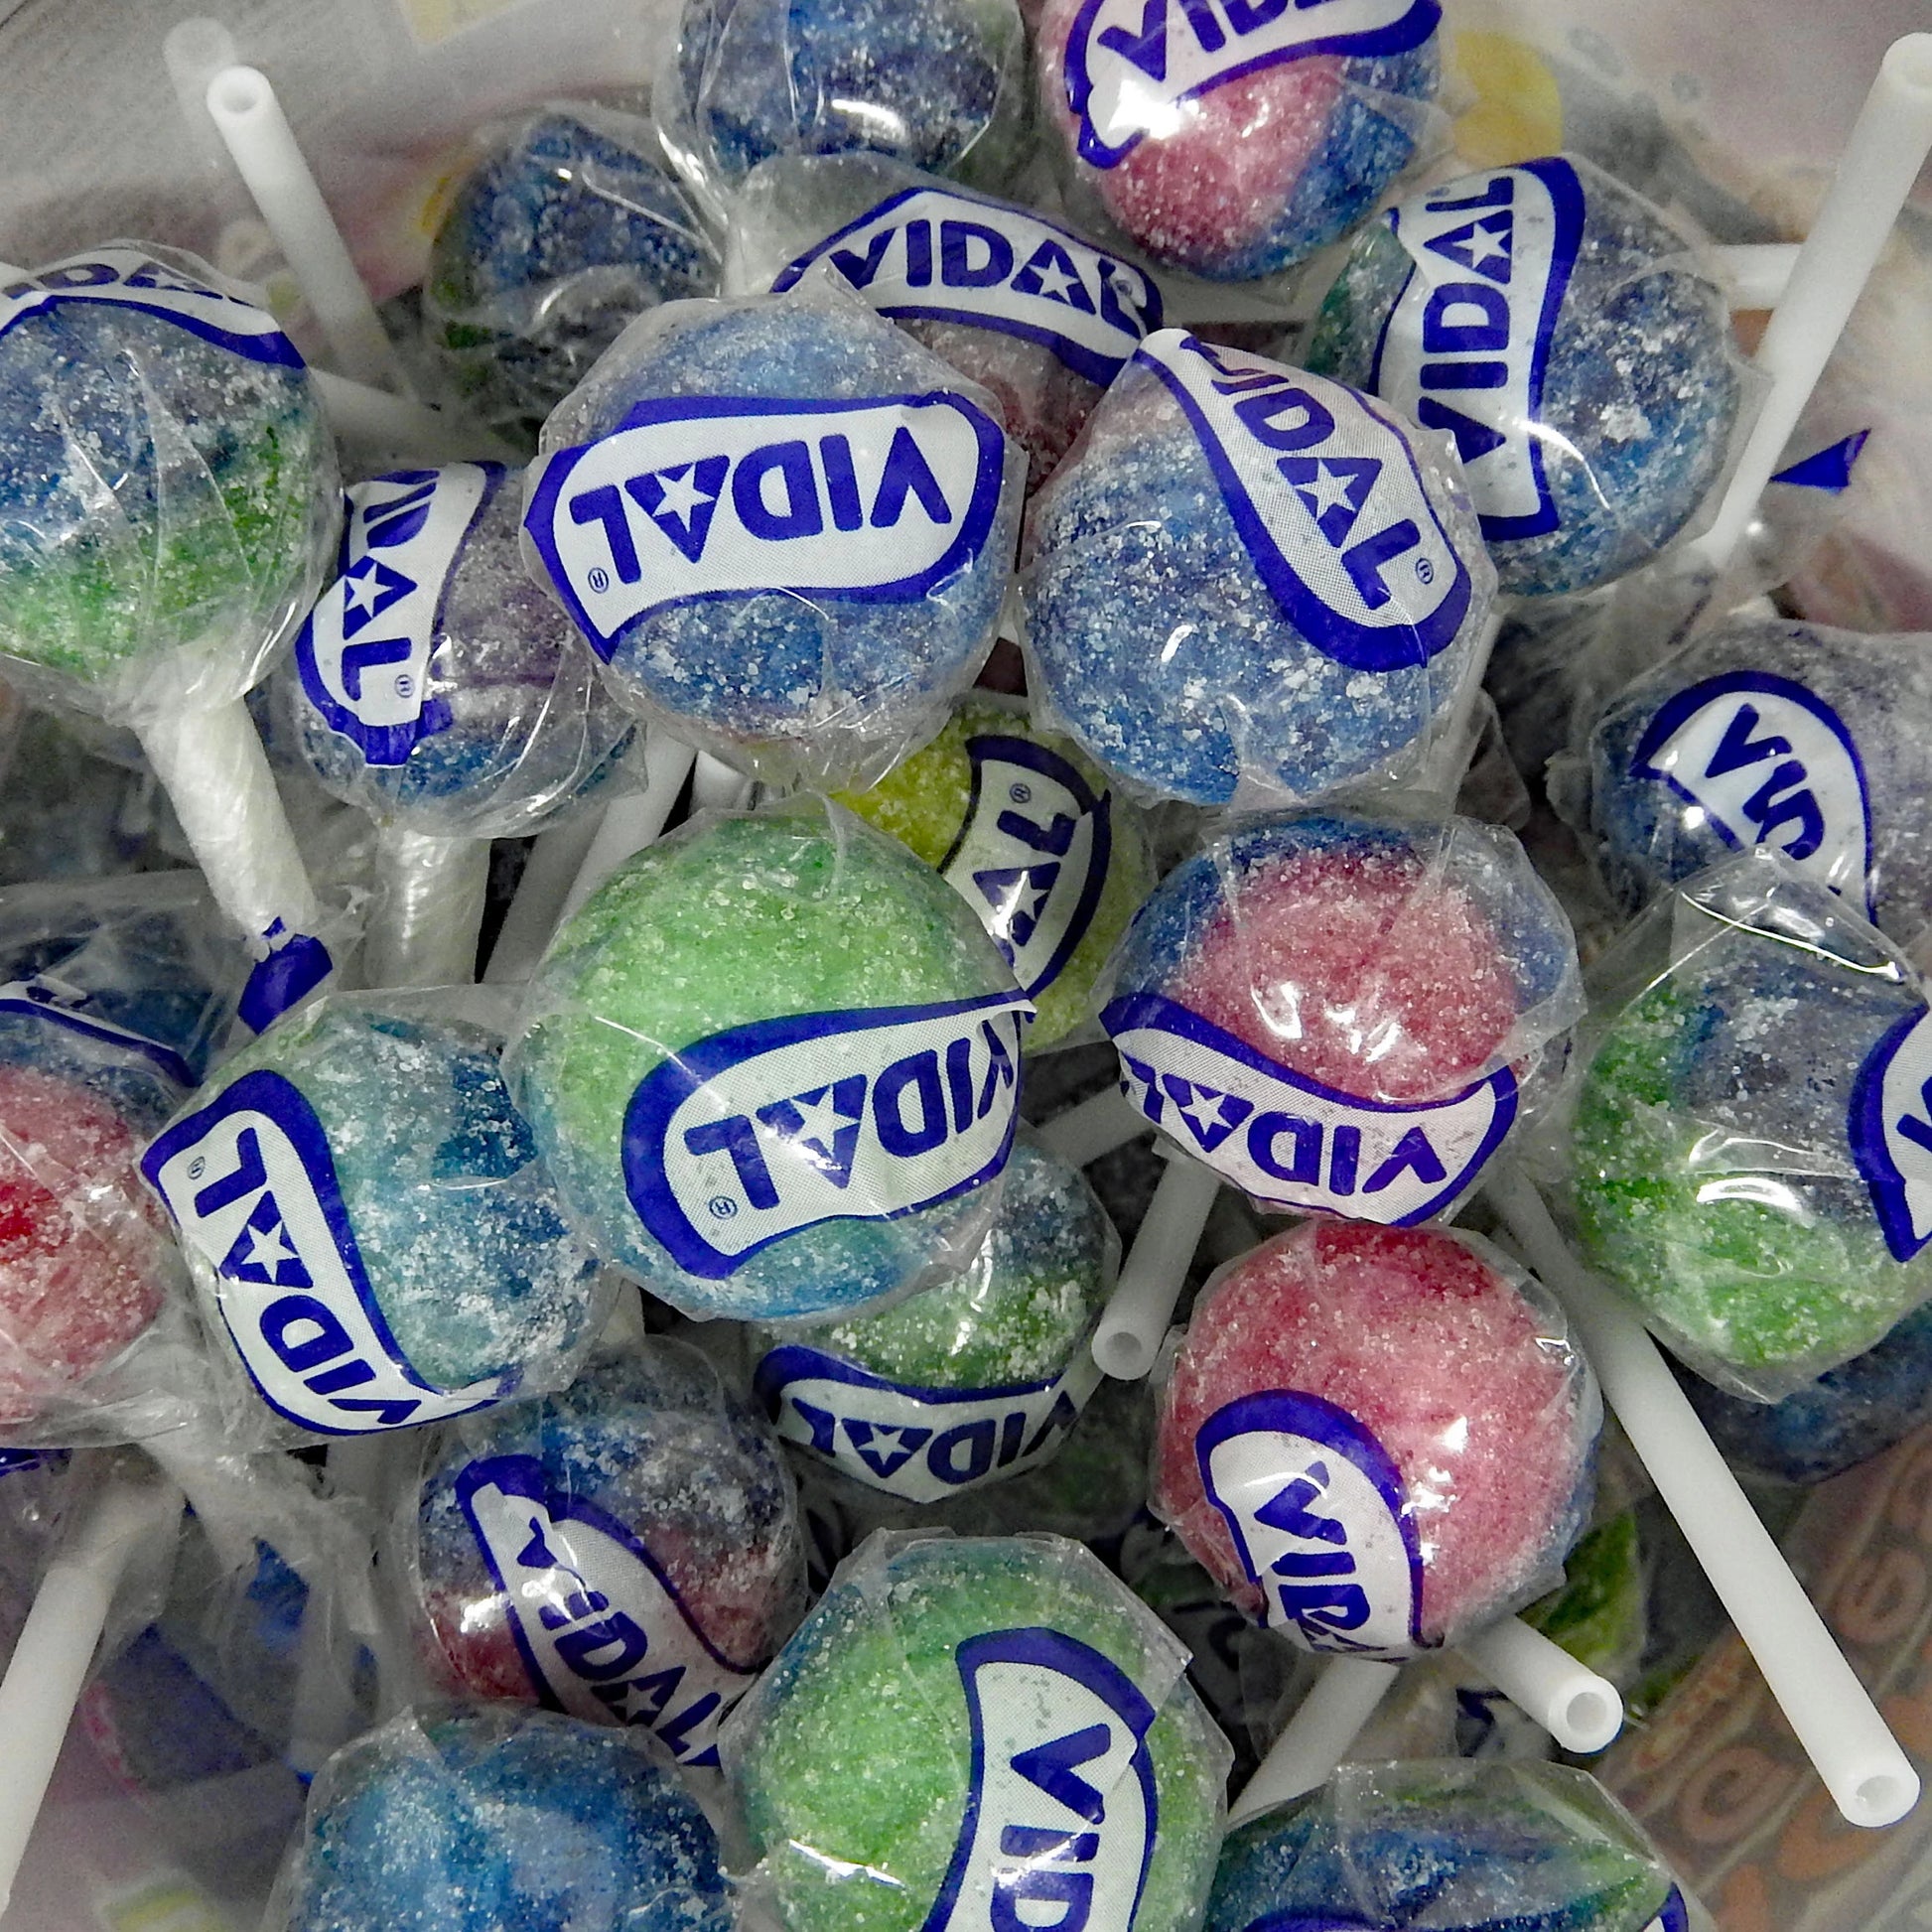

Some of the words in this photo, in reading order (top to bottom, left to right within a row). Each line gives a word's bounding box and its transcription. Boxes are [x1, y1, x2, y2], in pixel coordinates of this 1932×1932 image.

[1097, 0, 1336, 81] VID
[1418, 176, 1514, 464] VIDAL
[569, 426, 953, 584] VIDAL
[1179, 336, 1421, 611] VIDAL
[683, 1020, 1015, 1210] VIDAL
[194, 1127, 422, 1425] VIDAL
[791, 1390, 1077, 1485] VIDAL
